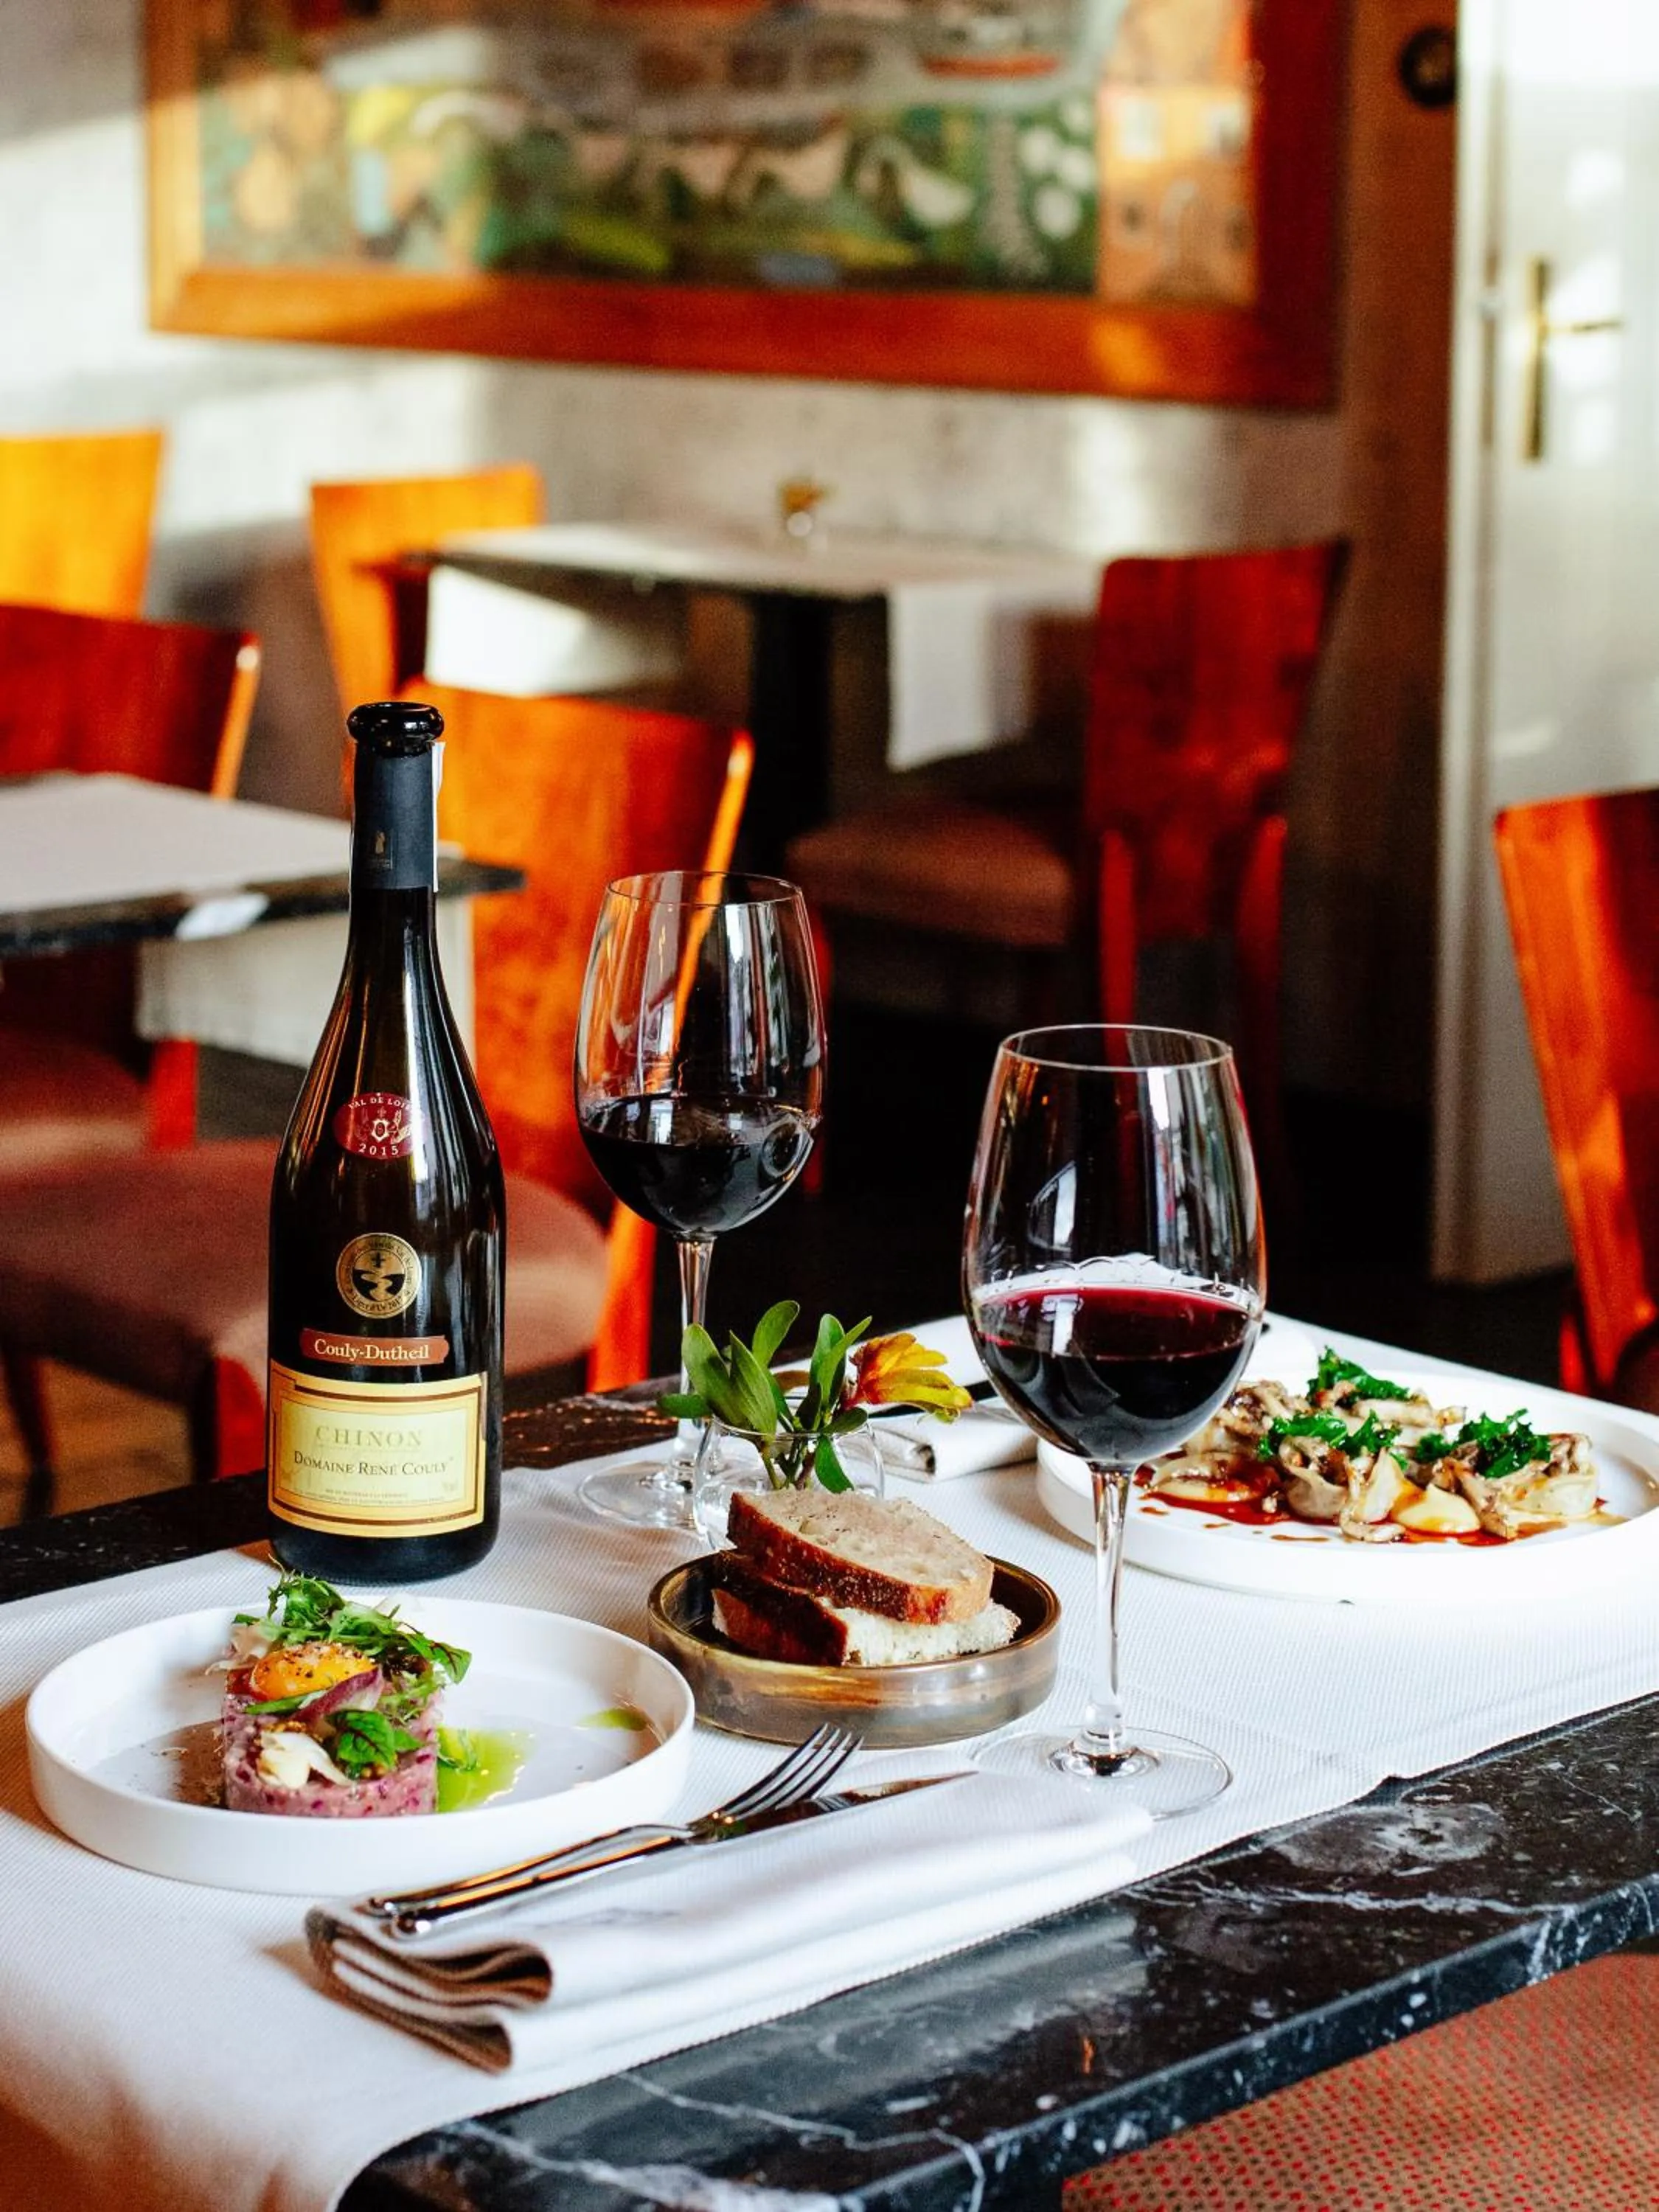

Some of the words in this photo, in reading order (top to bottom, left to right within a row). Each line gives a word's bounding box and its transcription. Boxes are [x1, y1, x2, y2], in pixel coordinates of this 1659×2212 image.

[348, 1099, 366, 1110] VAL
[359, 1143, 399, 1155] 2015
[314, 1338, 429, 1361] Couly-Dutheil
[316, 1425, 422, 1446] CHINON
[294, 1450, 355, 1473] DOMAINE
[402, 1461, 448, 1475] COULY
